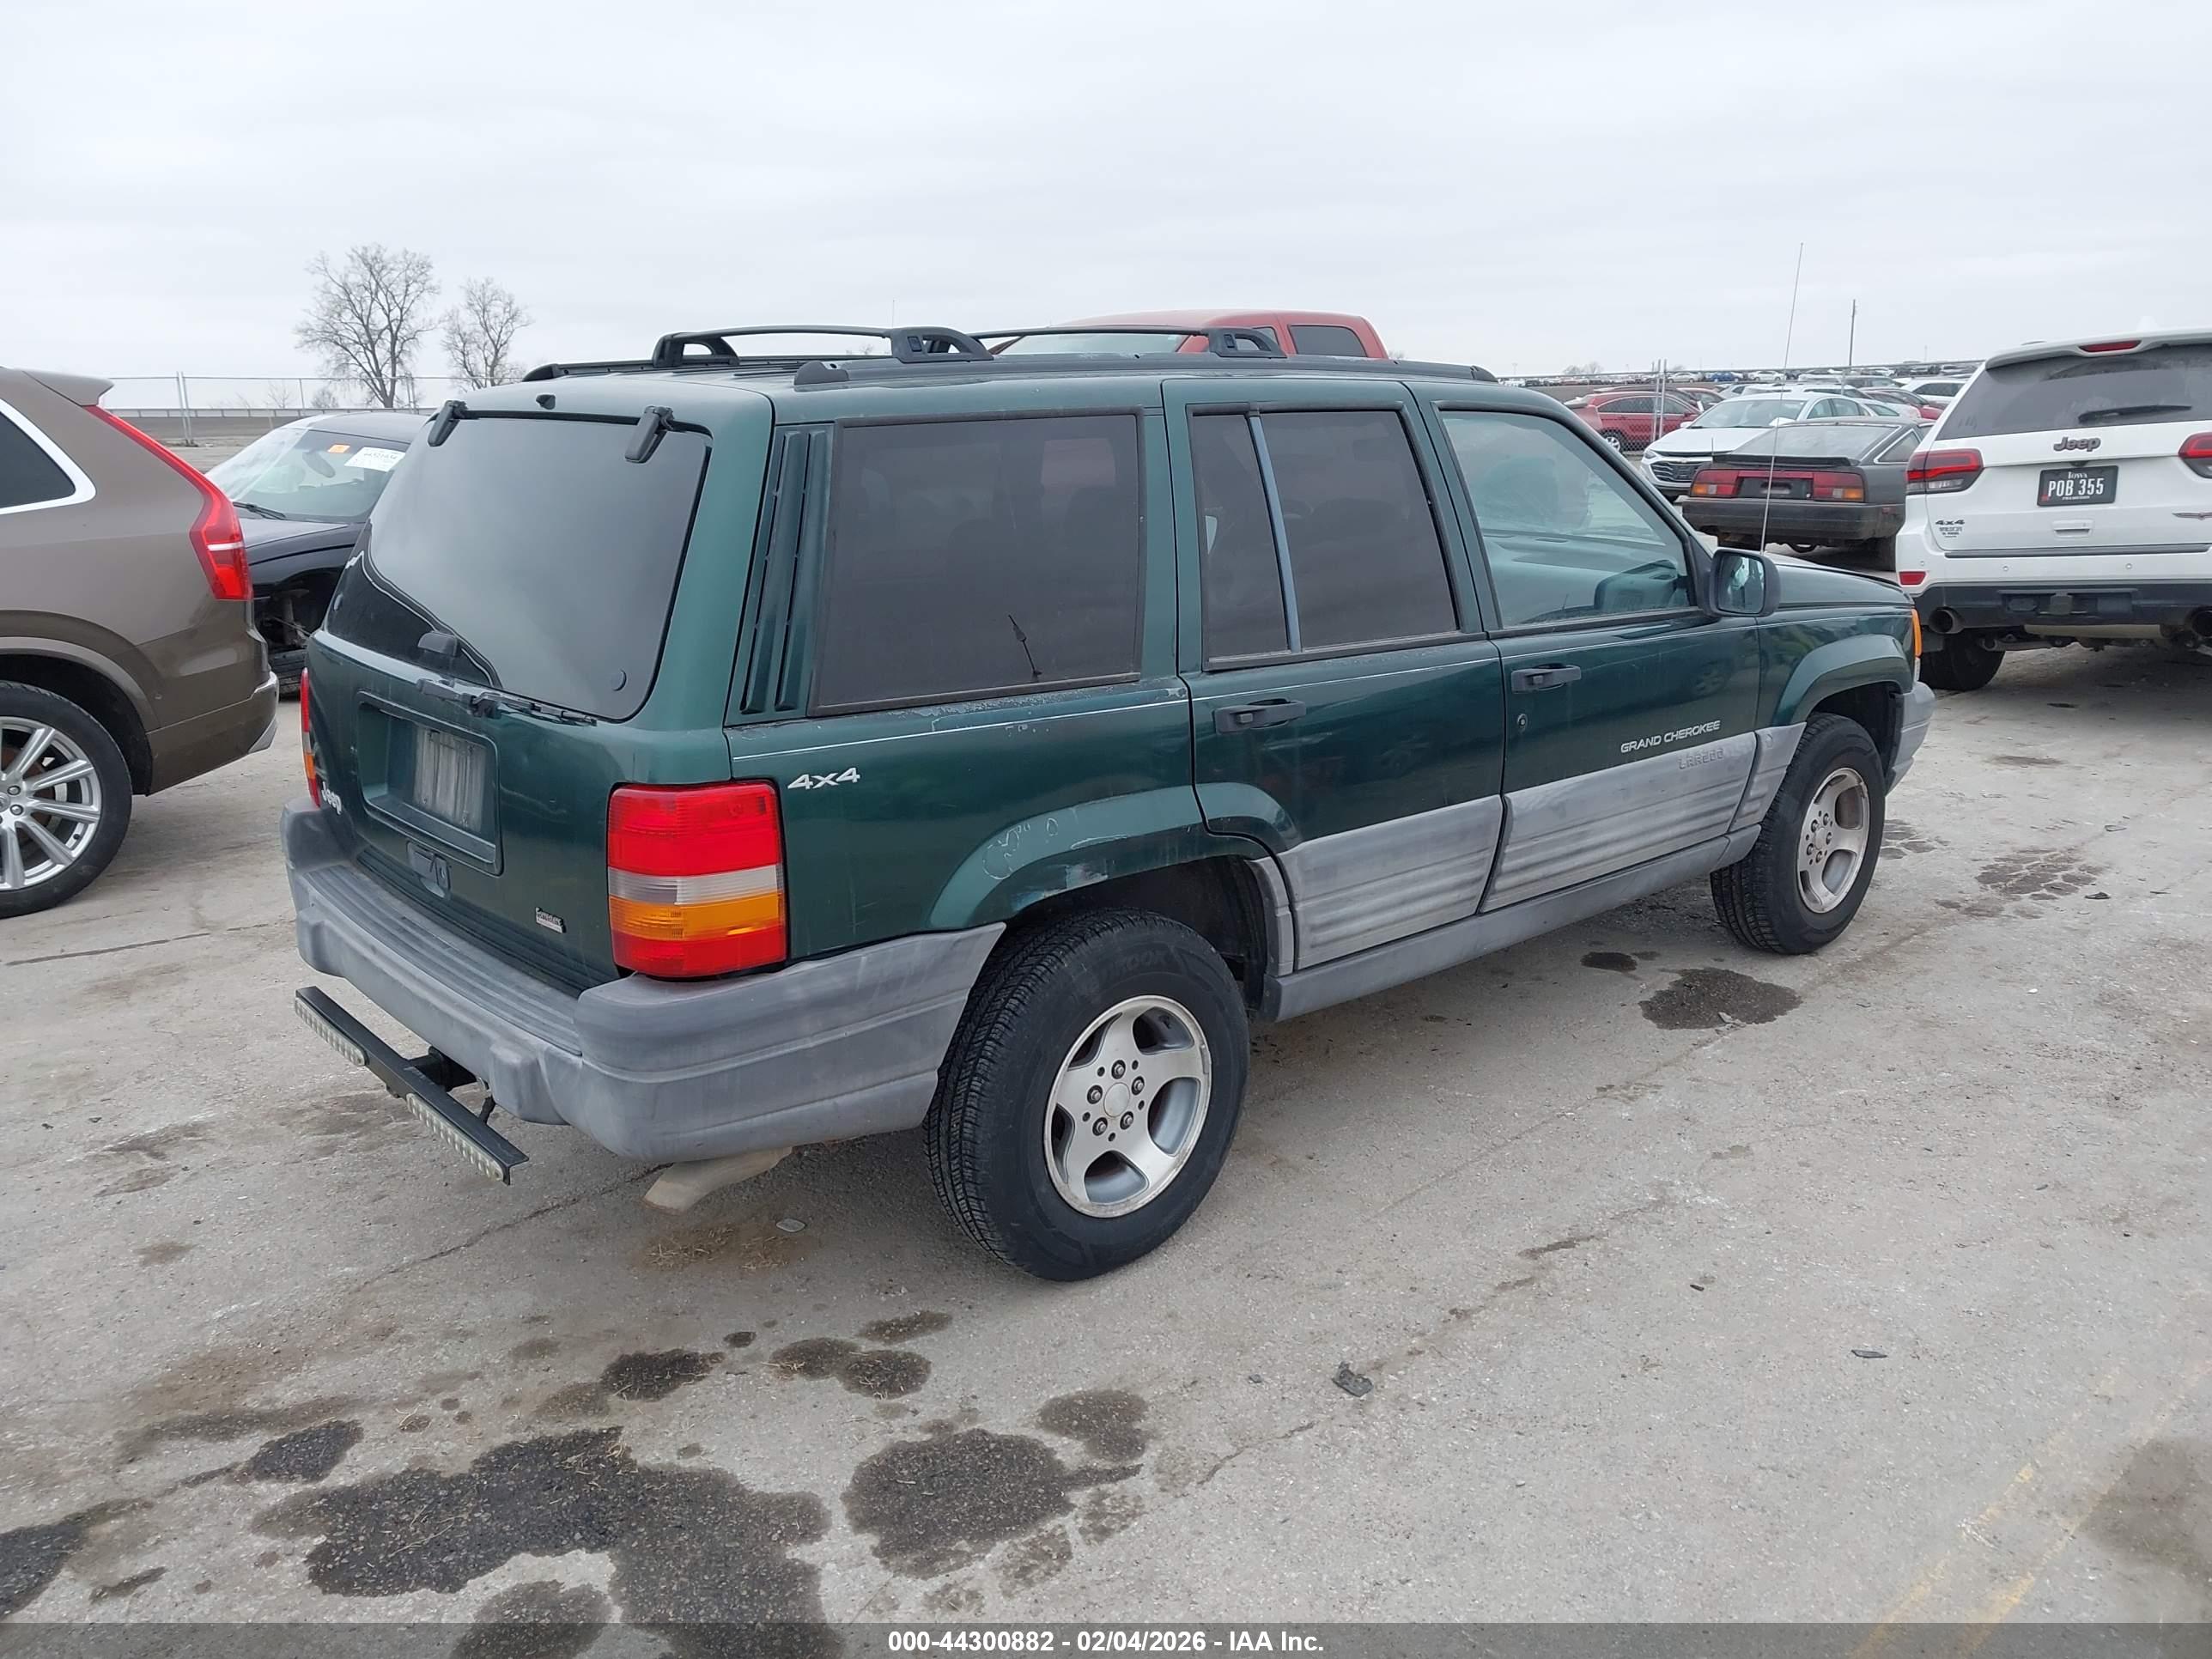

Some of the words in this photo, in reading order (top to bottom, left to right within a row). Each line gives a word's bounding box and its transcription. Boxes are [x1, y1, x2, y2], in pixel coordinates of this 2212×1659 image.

[2053, 436, 2101, 453] Jeep
[2048, 480, 2074, 497] POB
[2078, 478, 2105, 495] 355
[1620, 735, 1662, 753] GRAND
[1663, 720, 1721, 743] CHEROKEE
[321, 781, 342, 815] Jeep
